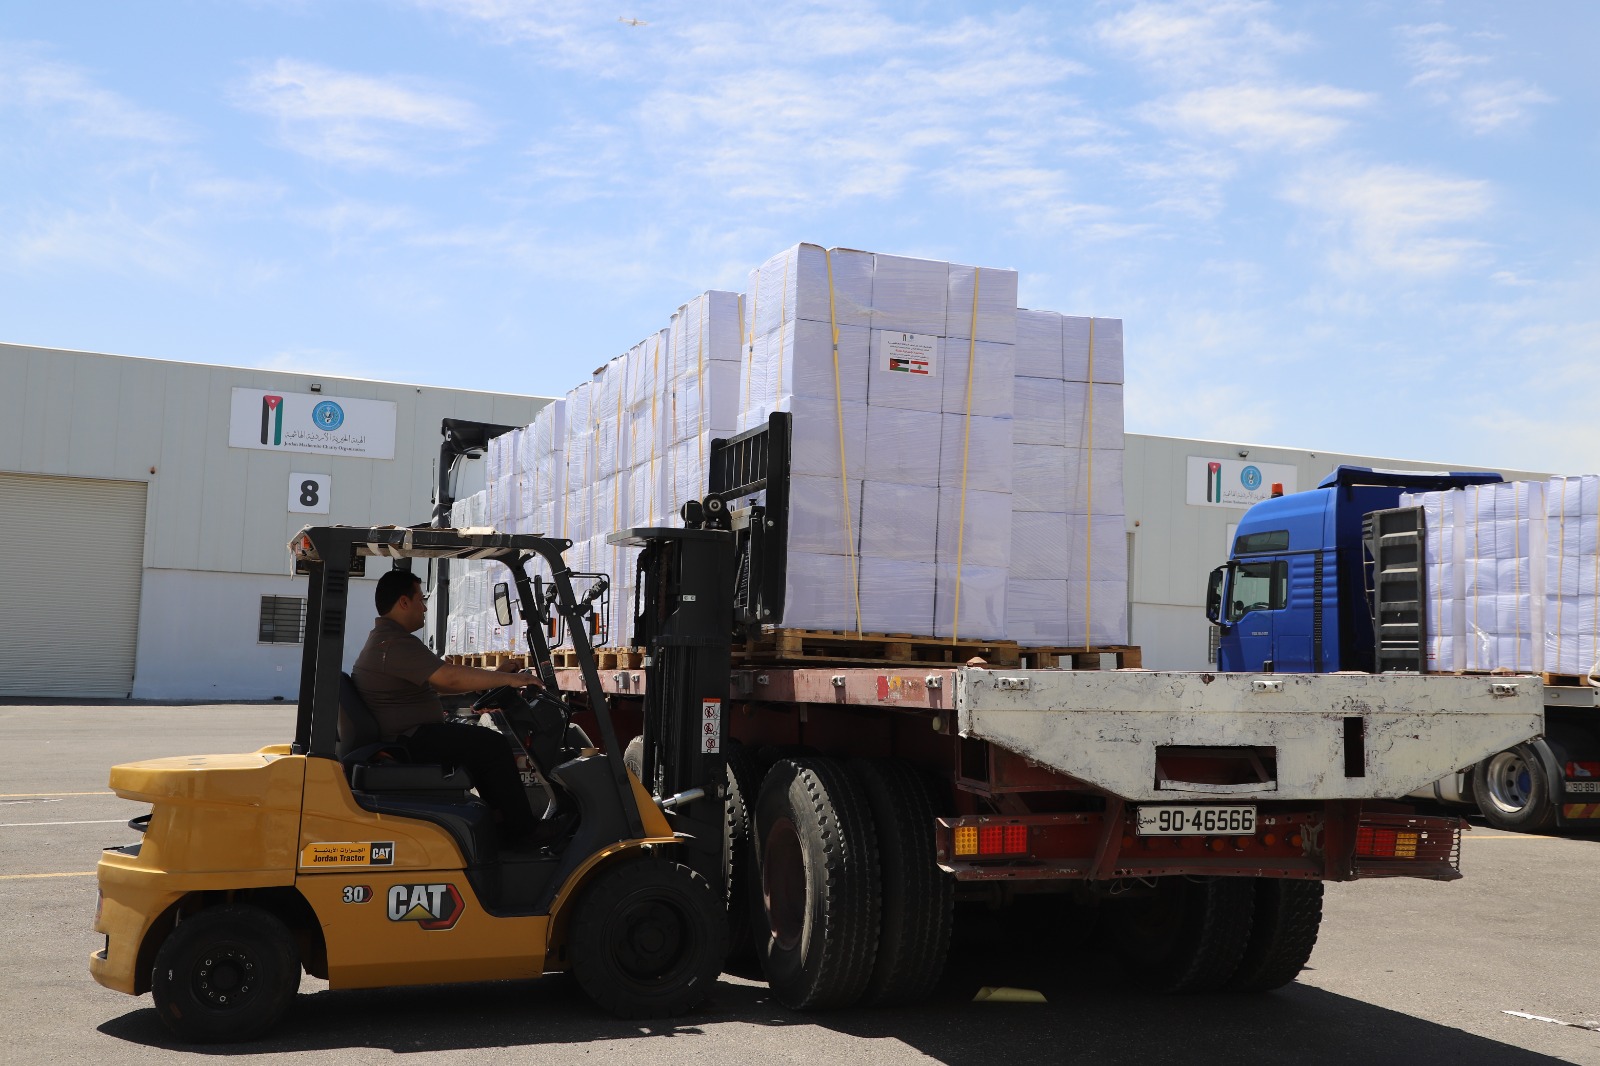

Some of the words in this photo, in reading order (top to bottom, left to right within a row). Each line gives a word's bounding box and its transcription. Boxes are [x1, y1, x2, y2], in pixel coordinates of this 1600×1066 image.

[300, 480, 319, 506] 8
[1159, 810, 1253, 831] 90-46566
[312, 854, 338, 863] Jordan
[339, 854, 365, 862] Tractor
[372, 848, 391, 860] CAT
[342, 886, 364, 903] 30
[388, 884, 447, 921] CAT
